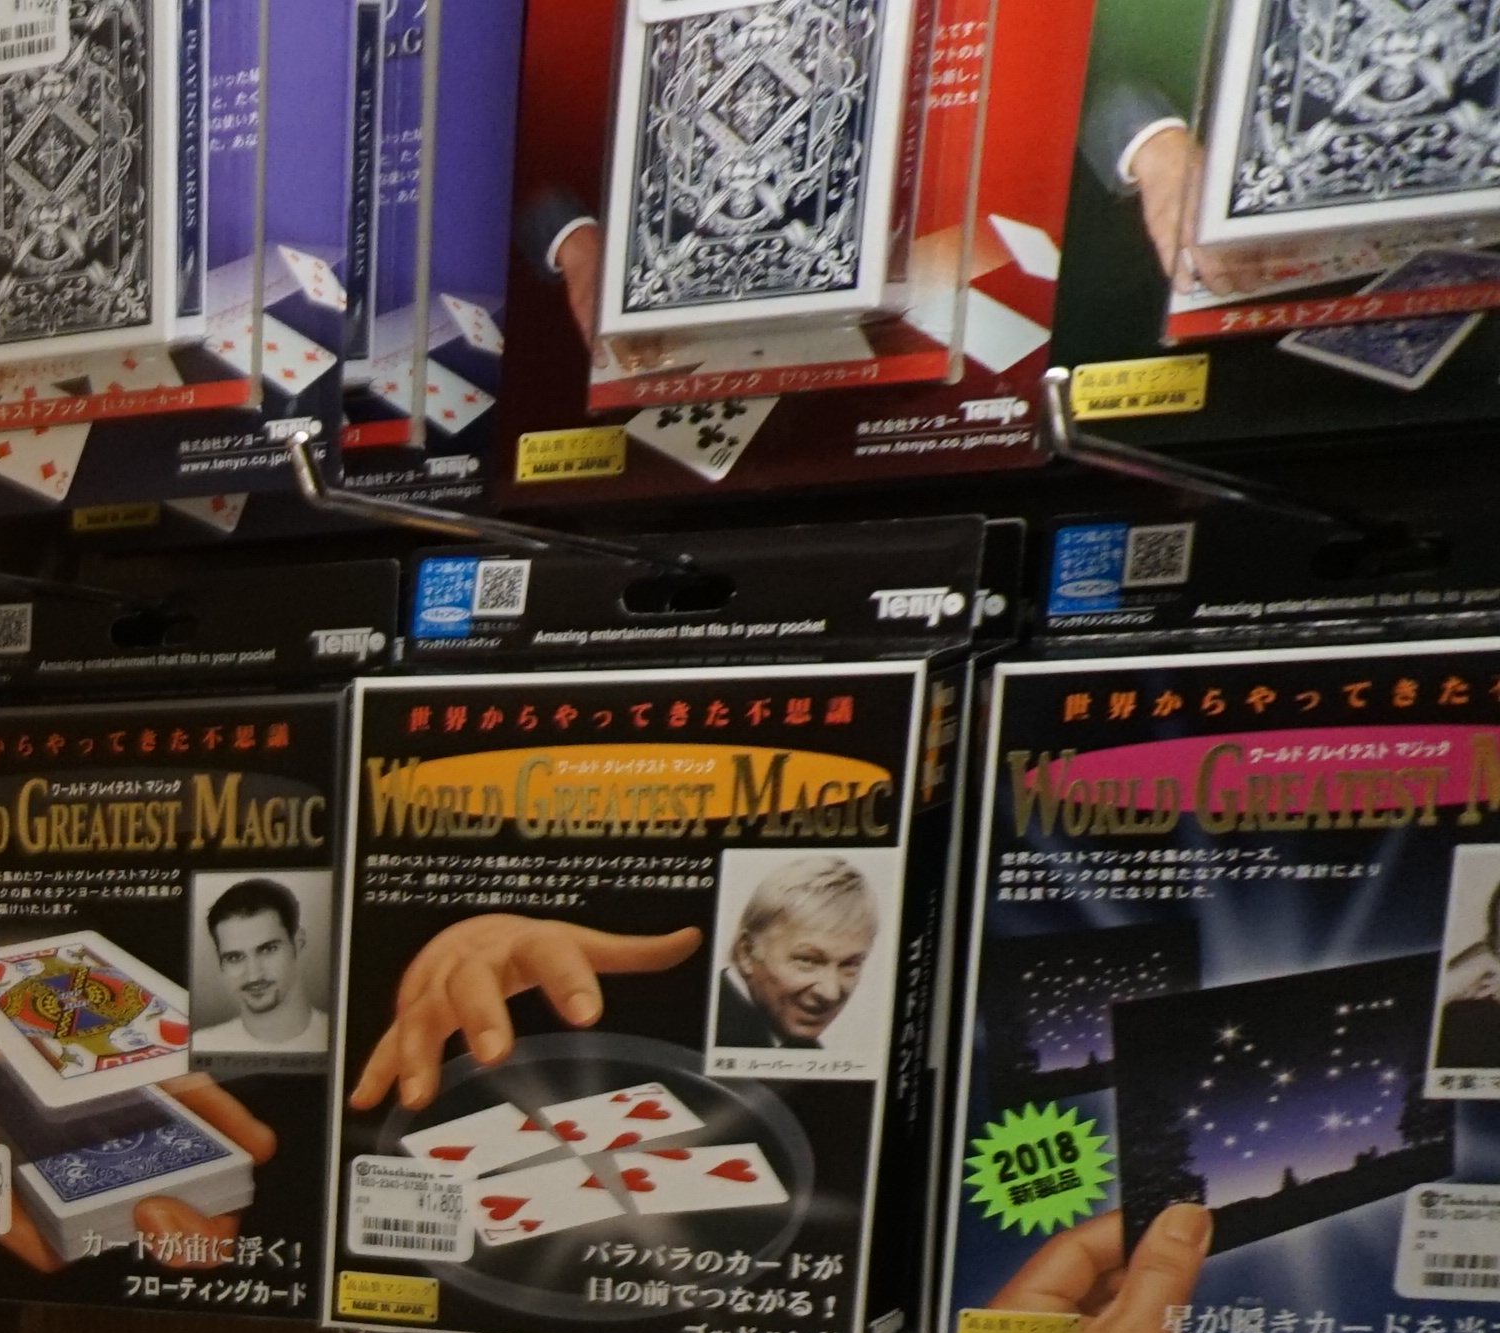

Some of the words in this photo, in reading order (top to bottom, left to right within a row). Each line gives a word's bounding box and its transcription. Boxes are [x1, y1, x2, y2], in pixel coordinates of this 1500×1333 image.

[960, 398, 1030, 424] Tenyo
[425, 454, 480, 480] Tenyo
[869, 586, 966, 627] Tenyo
[310, 627, 386, 660] Tenyo
[533, 628, 587, 646] Amazing
[590, 626, 677, 642] entertainment
[680, 623, 704, 638] that
[707, 623, 728, 638] fits
[746, 622, 777, 640] your
[780, 618, 826, 636] pocket
[39, 656, 83, 672] Amazing
[85, 654, 154, 670] entertainment
[157, 651, 177, 666] that
[212, 651, 237, 666] your
[241, 648, 277, 664] pocket
[365, 755, 504, 840] WORLD
[514, 752, 716, 837] GREATEST
[722, 752, 892, 838] MAGIC
[1007, 748, 1181, 838] WORLD
[1198, 741, 1450, 835] GREATEST
[18, 777, 181, 854] GREATEST
[191, 772, 326, 849] MAGIC
[992, 1130, 1081, 1183] 2018
[1007, 1168, 1084, 1207] 新製品
[583, 1242, 844, 1279] バラバラのカードが
[125, 1275, 307, 1306] フローティングカード
